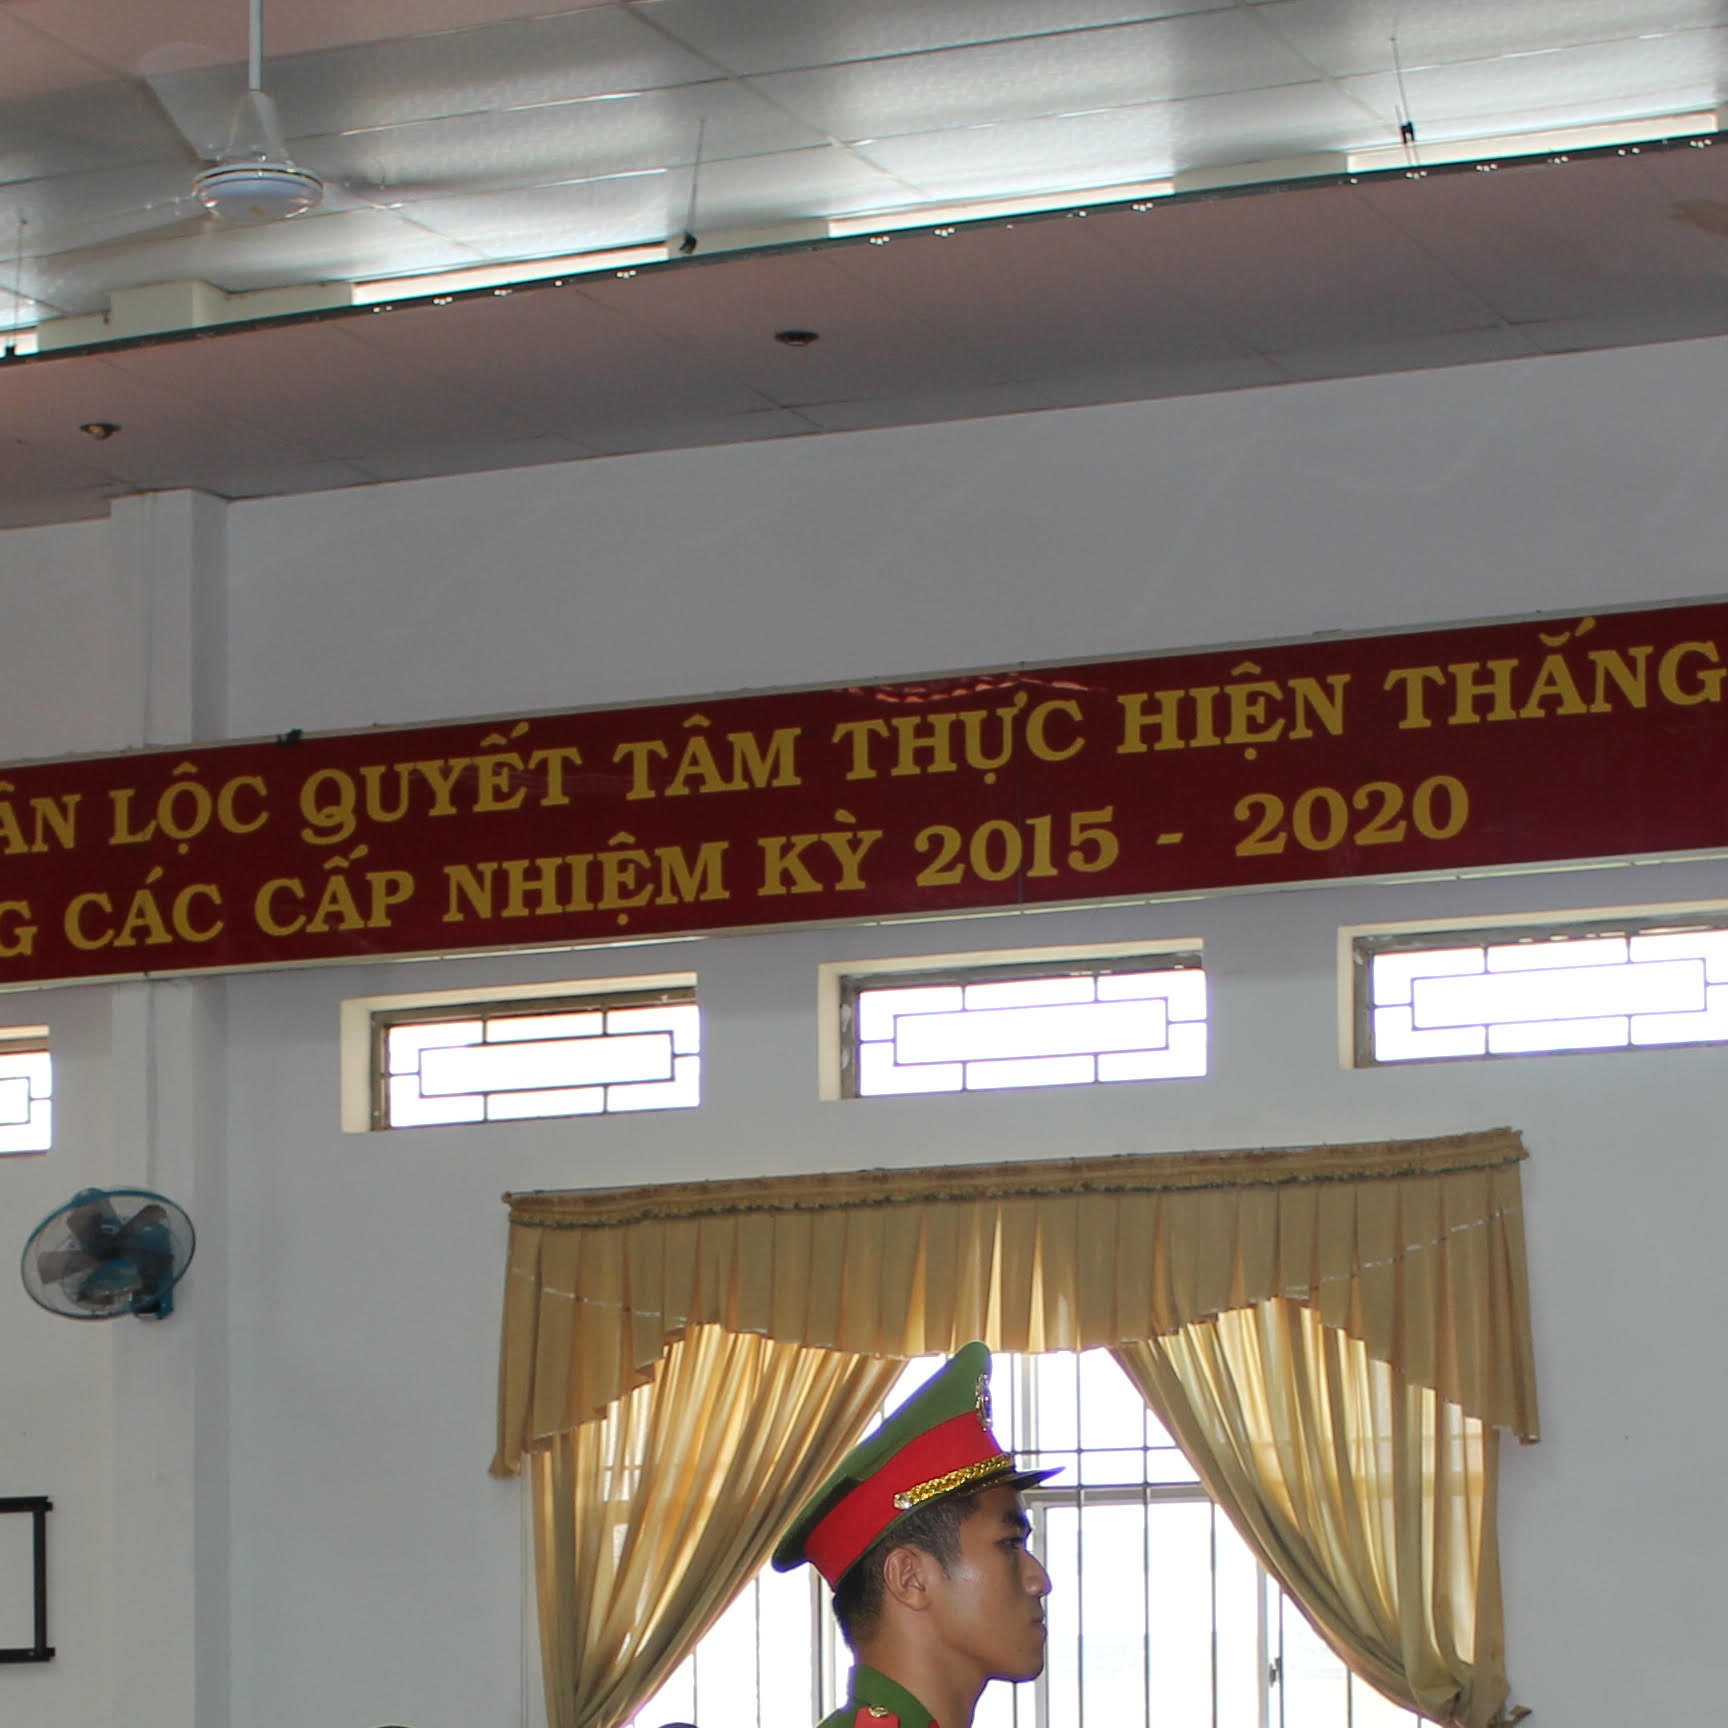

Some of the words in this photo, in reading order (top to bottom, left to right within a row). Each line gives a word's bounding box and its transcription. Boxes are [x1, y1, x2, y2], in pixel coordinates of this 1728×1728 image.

[108, 761, 270, 856] LỘC
[299, 720, 584, 846] QUYẾT
[611, 713, 803, 802] TÂM
[830, 689, 1087, 786] THỰC
[1115, 660, 1353, 761] HIỆN
[1383, 615, 1728, 731] THẮNG
[63, 865, 225, 951] CÁC
[253, 843, 416, 938] CẤP
[441, 830, 732, 926] NHIỆM
[756, 807, 884, 898] KỲ
[913, 804, 1121, 888] 2015
[1156, 831, 1185, 846] -
[1233, 774, 1470, 858] 2020
